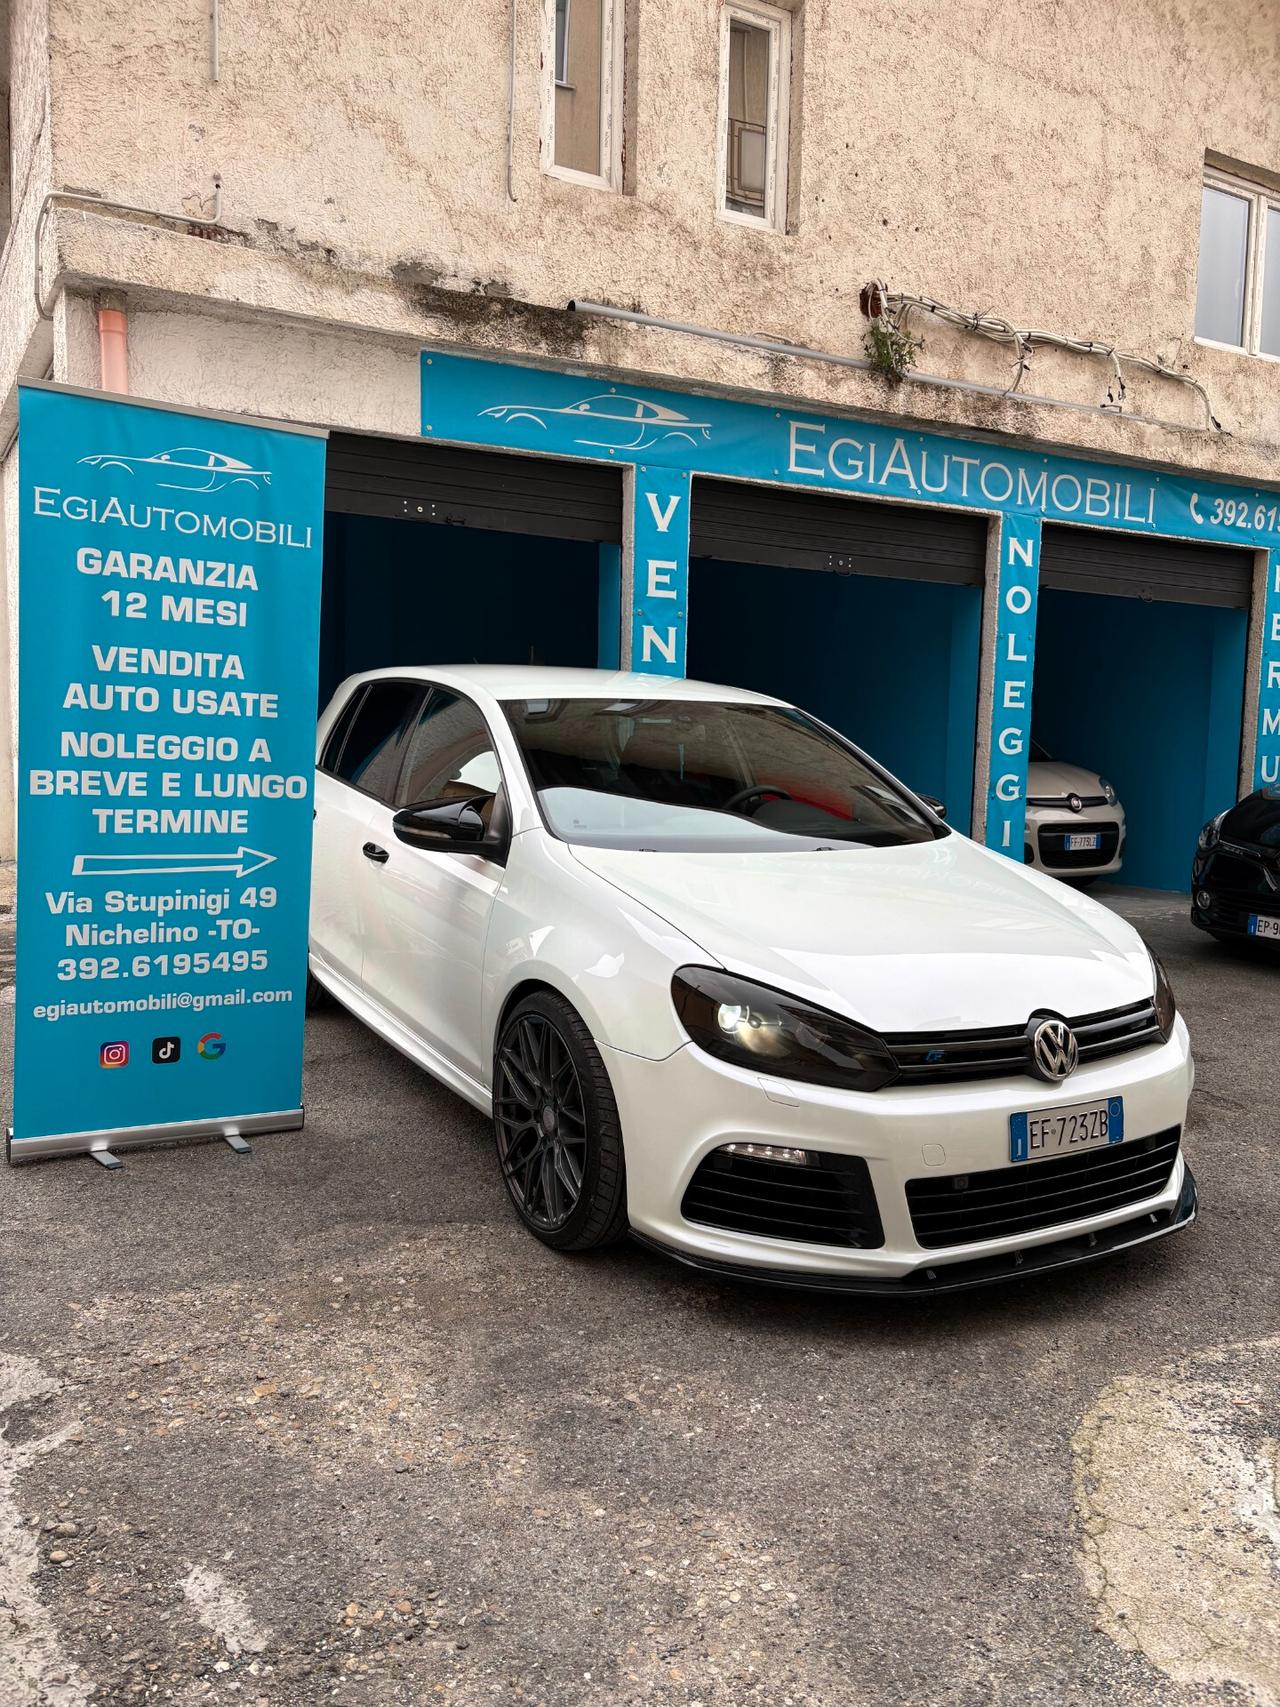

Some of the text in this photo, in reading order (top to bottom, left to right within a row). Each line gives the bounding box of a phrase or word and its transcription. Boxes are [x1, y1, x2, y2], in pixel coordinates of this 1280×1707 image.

[1210, 498, 1280, 534] 392.61
[76, 547, 259, 591] GARANZIA
[101, 590, 247, 627] 12 MESI
[91, 644, 245, 680] VENDITA
[62, 682, 279, 718] AUTO USATE
[995, 536, 1034, 847] NOLEGGI
[60, 731, 272, 763] NOLEGGIO A
[29, 769, 308, 799] BREVE E LUNGO
[92, 808, 249, 834] TERMINE
[45, 886, 277, 917] Via Stupinigi 49
[65, 918, 260, 947] Nichelino -TO-
[57, 949, 268, 981] 392.6195495
[33, 989, 292, 1022] egiautomobili@gmail.com
